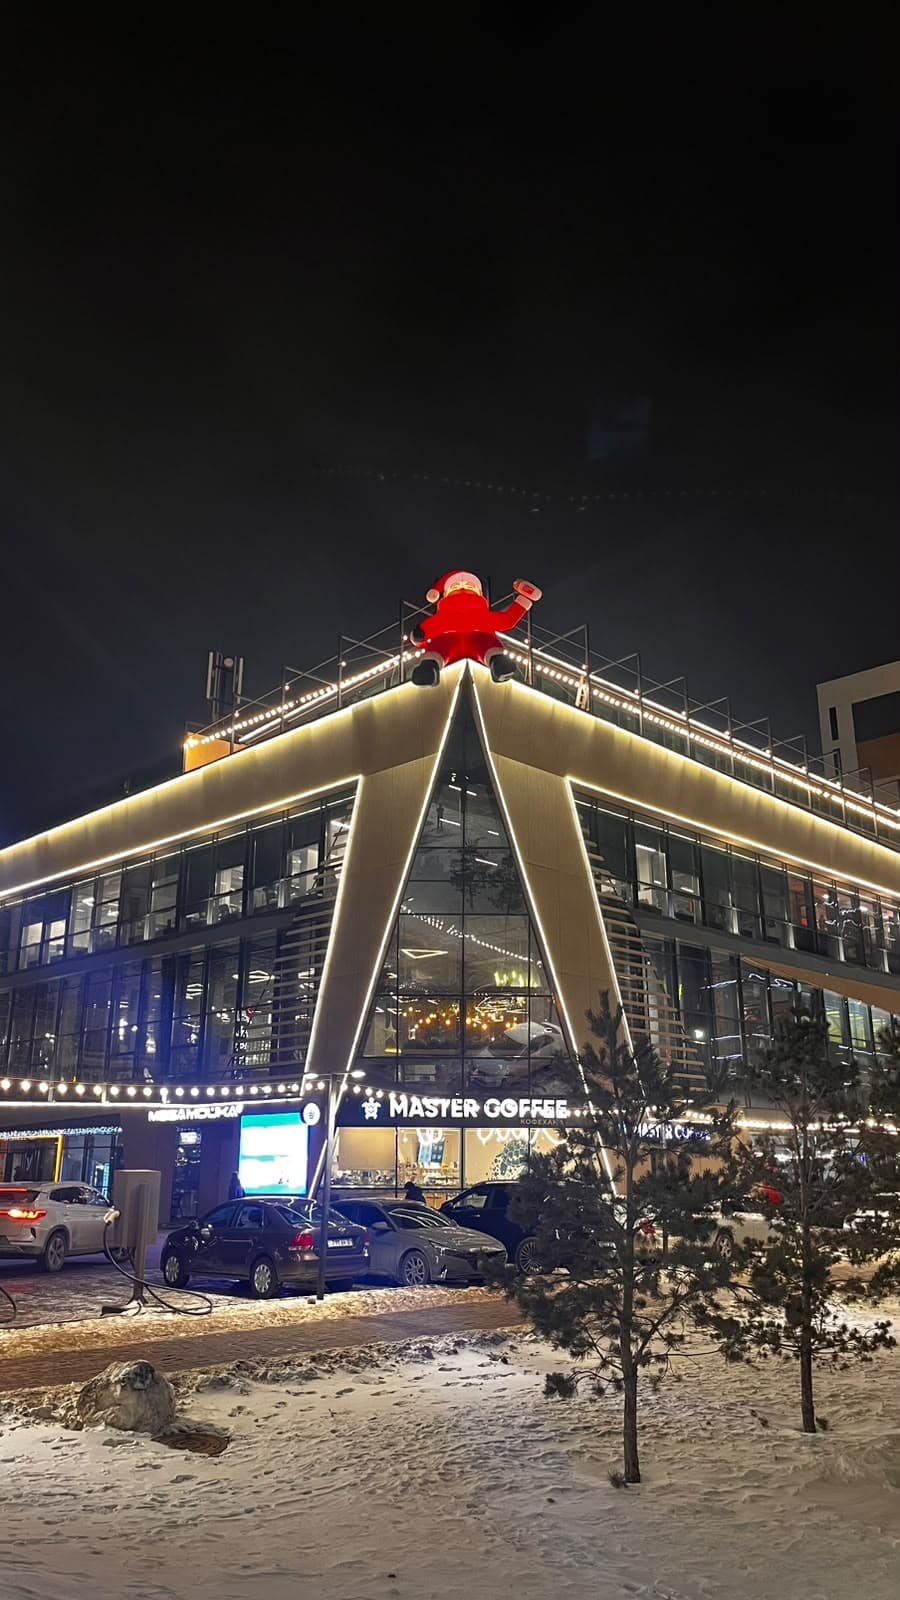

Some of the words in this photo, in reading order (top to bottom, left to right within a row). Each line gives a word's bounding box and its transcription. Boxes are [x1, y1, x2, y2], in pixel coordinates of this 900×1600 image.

[389, 1098, 479, 1118] MASTER
[484, 1098, 567, 1119] COFFEE
[633, 1122, 673, 1140] ASTR
